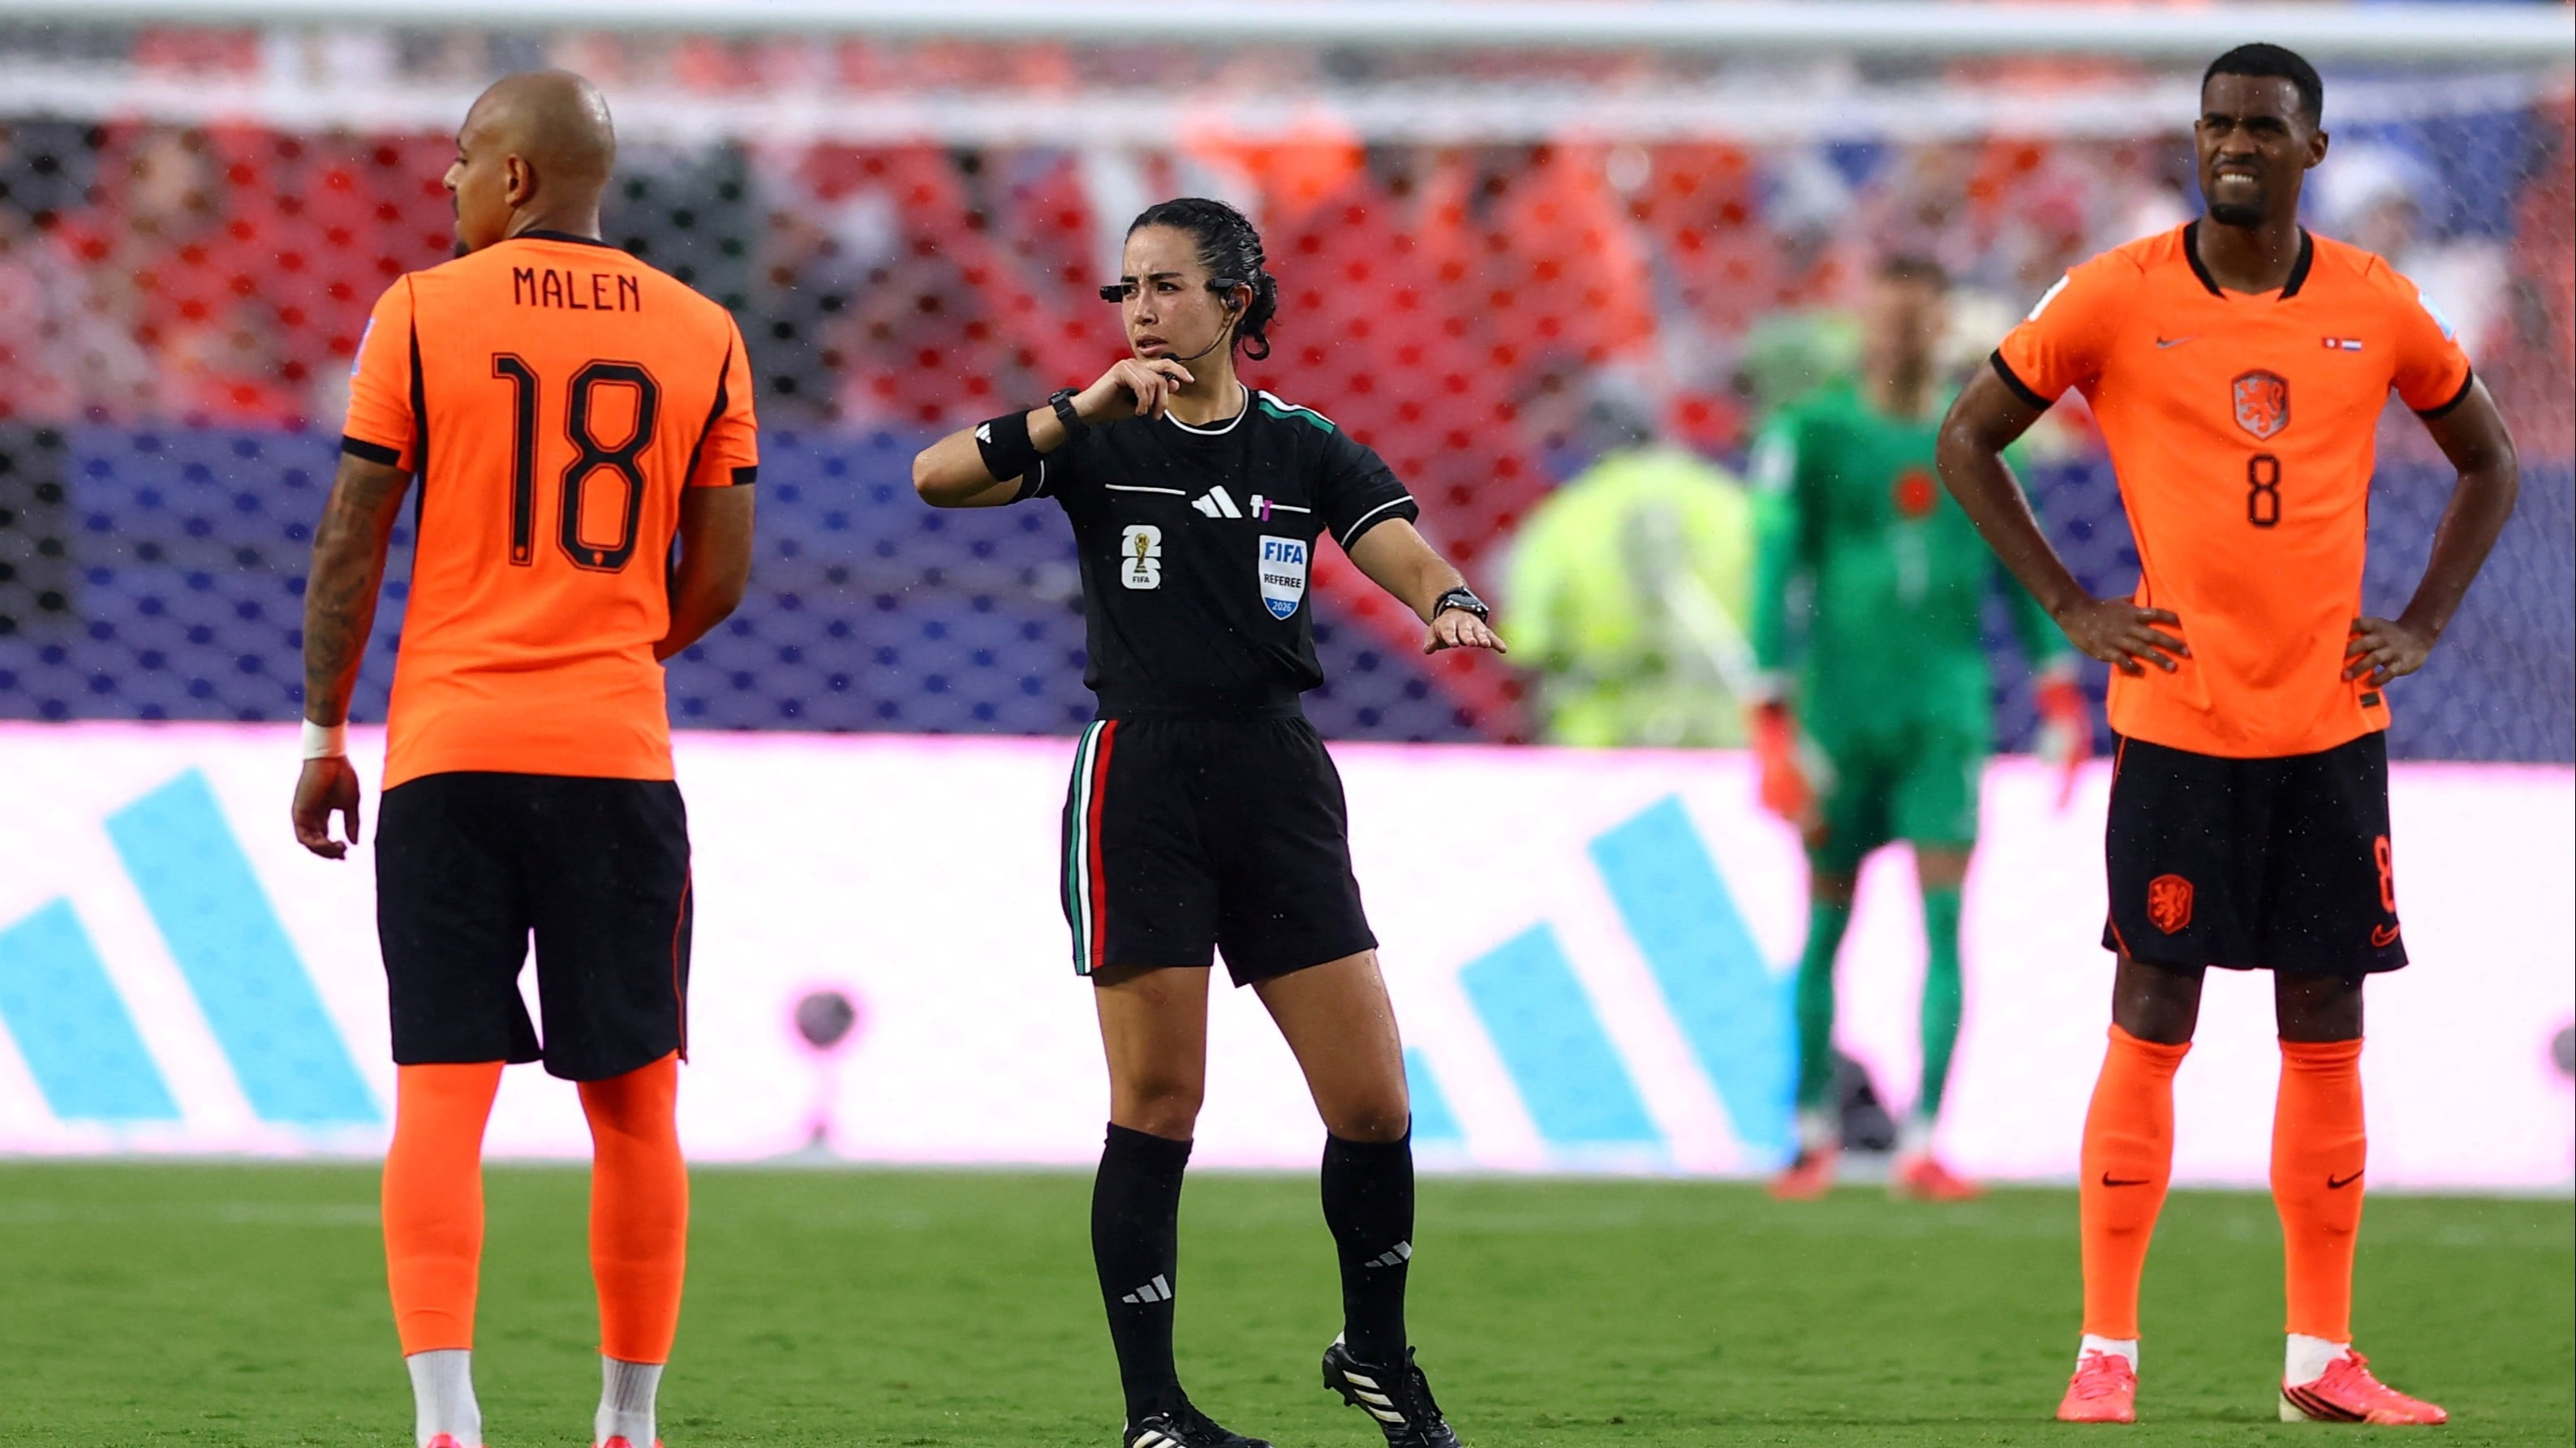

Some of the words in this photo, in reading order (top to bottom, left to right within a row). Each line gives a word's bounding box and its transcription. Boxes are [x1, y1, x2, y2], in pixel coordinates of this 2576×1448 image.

[513, 266, 640, 312] MALEN
[492, 352, 661, 574] 18
[2247, 453, 2281, 529] 8
[1264, 541, 1304, 565] FIFA
[1132, 575, 1150, 584] FIFA
[1263, 573, 1302, 589] REFEREE
[1271, 600, 1292, 612] 2026
